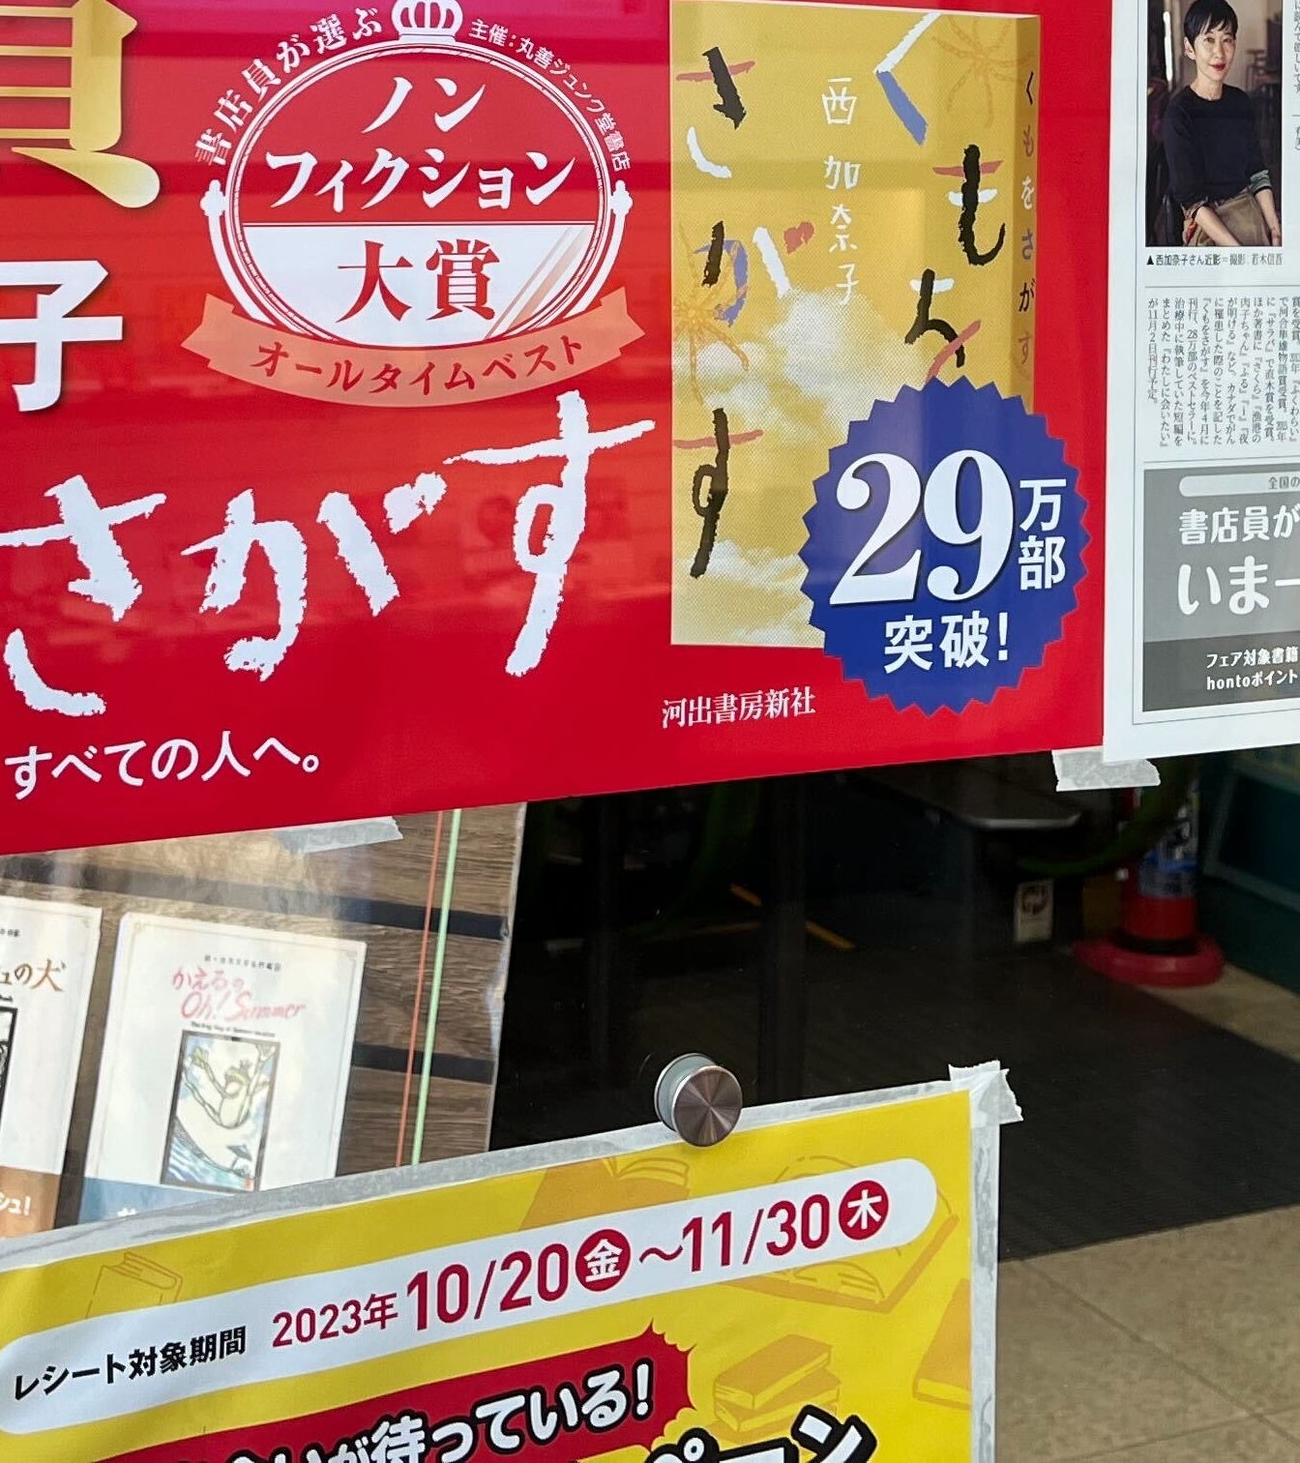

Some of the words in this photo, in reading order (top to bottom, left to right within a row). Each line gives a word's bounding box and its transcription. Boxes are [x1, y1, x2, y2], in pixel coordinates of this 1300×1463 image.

[194, 5, 382, 166] 書店員が選ぶ
[361, 77, 487, 134] ノン
[264, 146, 577, 213] フィクション
[335, 238, 500, 324] 大賞
[251, 334, 583, 395] オールタイムベスト
[829, 448, 1015, 607] 29
[1018, 476, 1068, 592] 万部
[884, 609, 1009, 675] 突破！
[1206, 645, 1299, 670] フェア対象書籍
[661, 688, 817, 730] 河出書房新社
[1206, 668, 1299, 691] hontoポイント
[12, 1325, 249, 1398] レシート対象期間
[271, 1292, 400, 1349] 2023年
